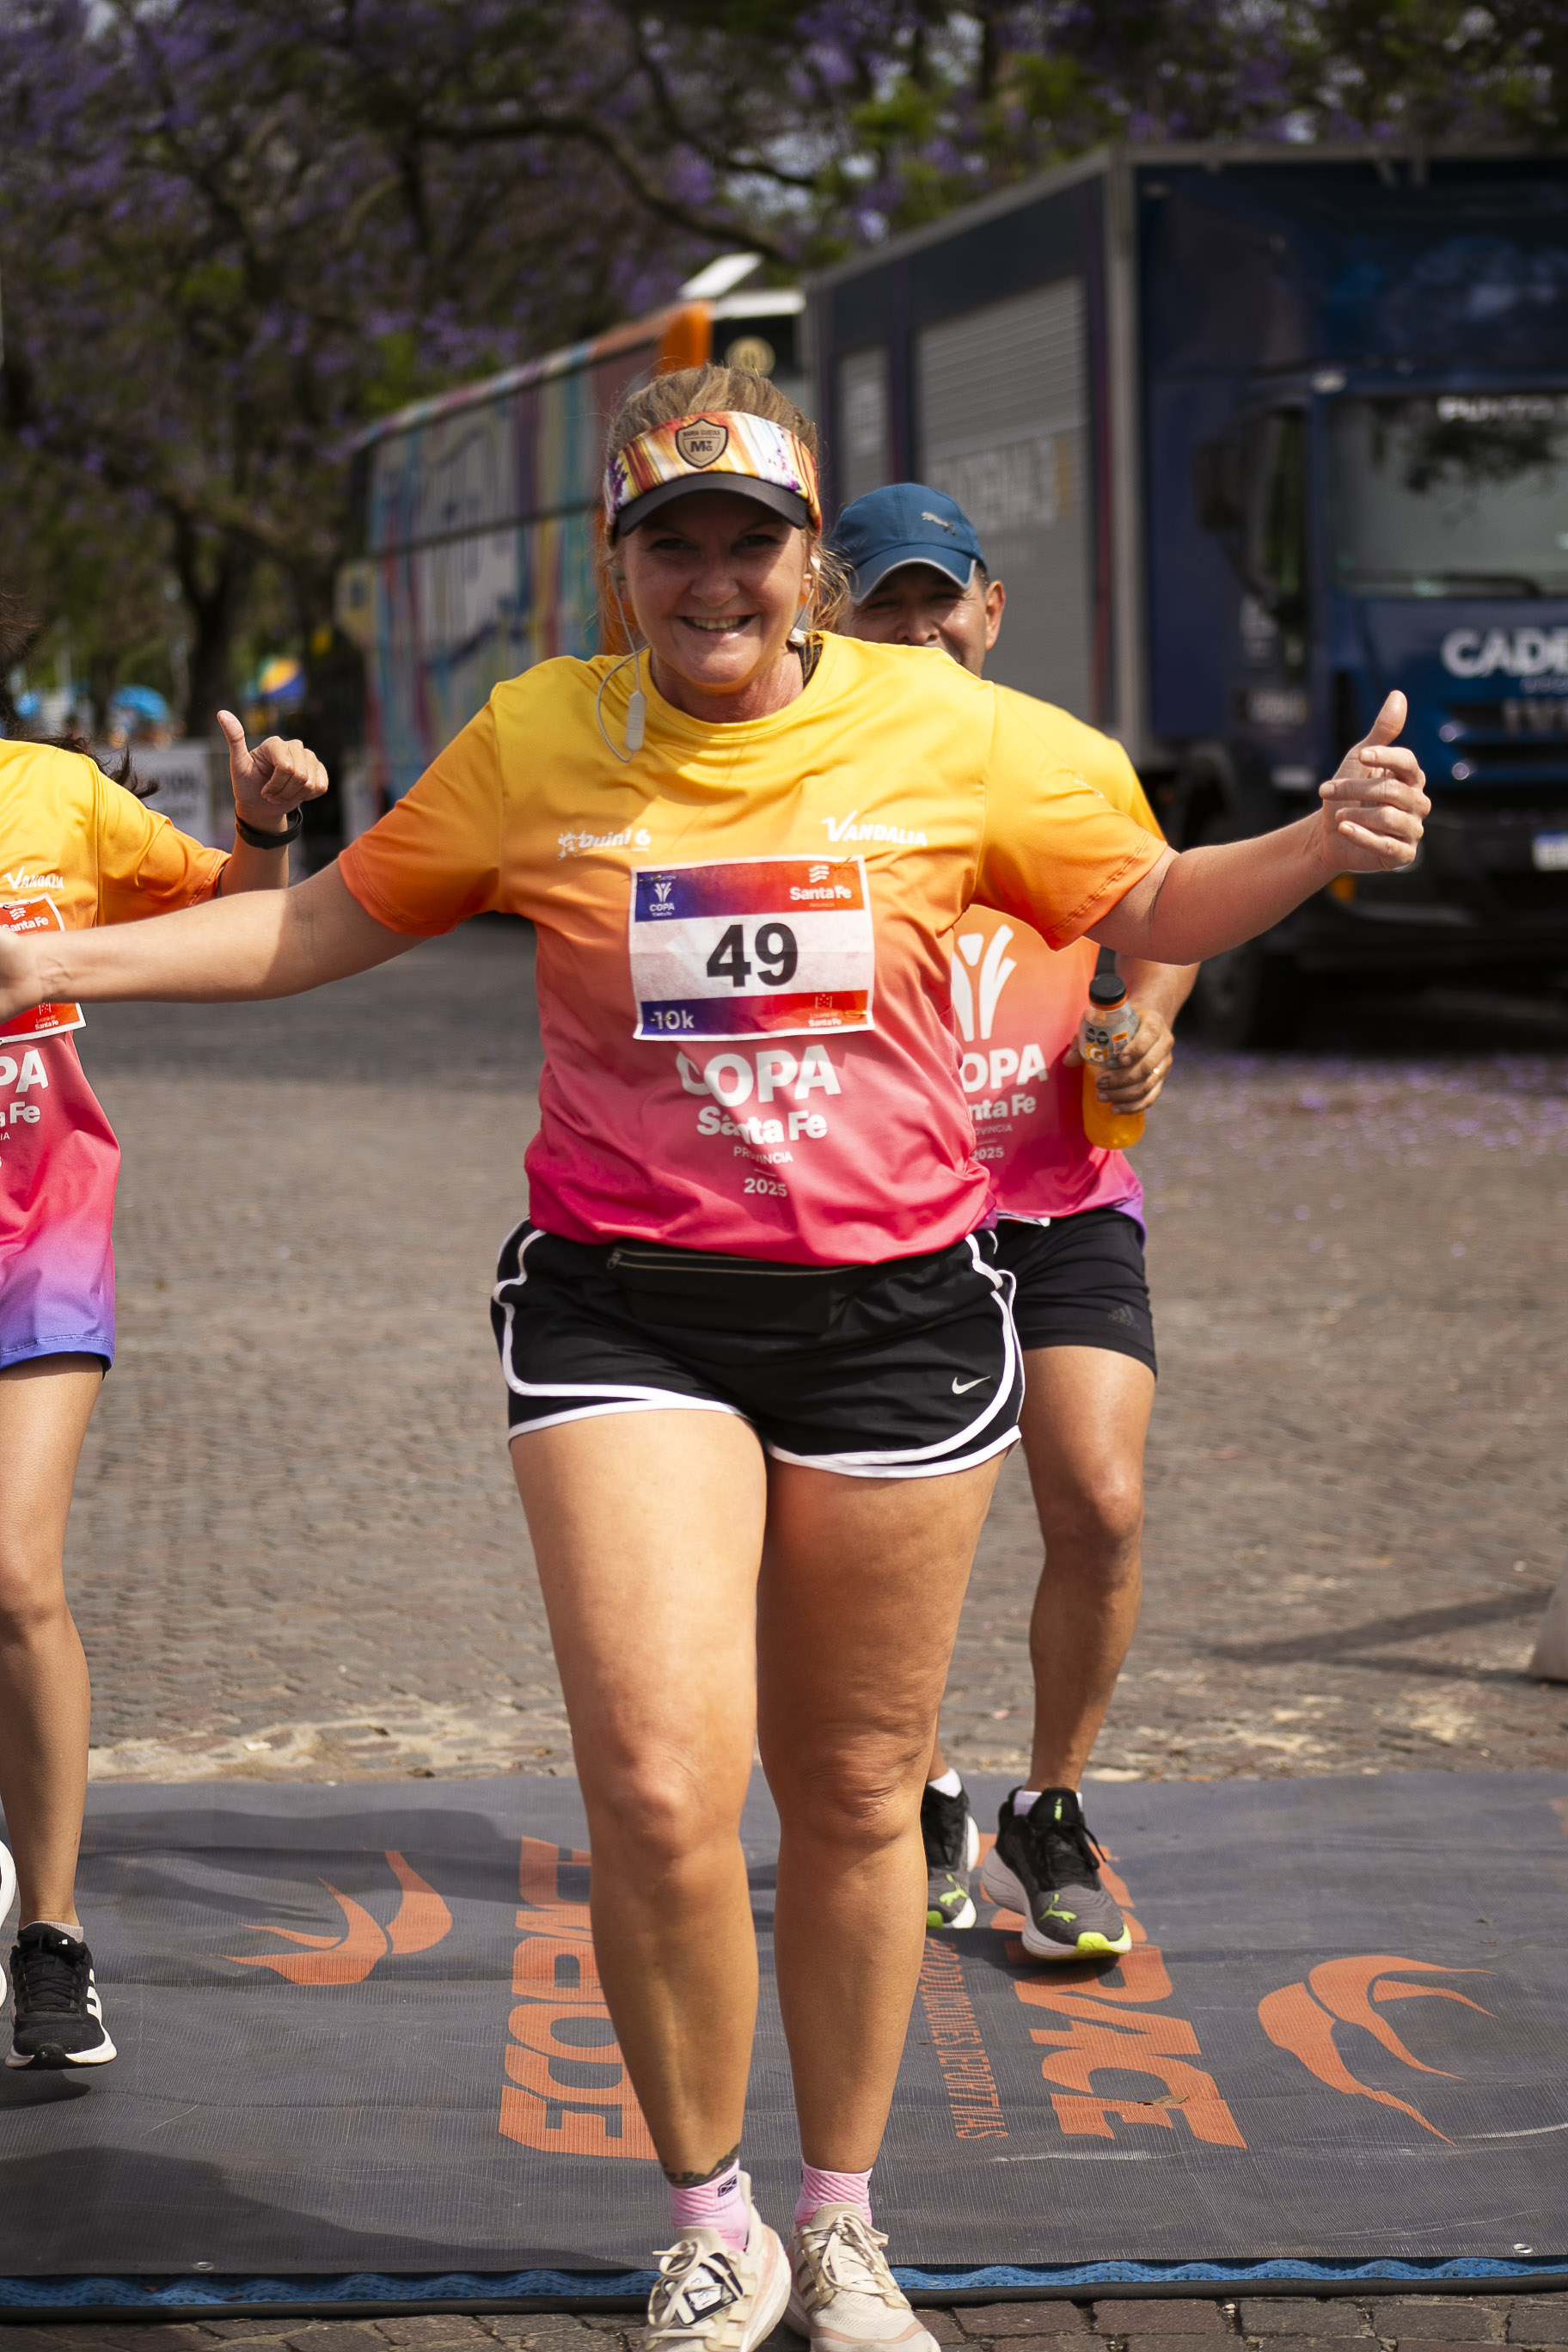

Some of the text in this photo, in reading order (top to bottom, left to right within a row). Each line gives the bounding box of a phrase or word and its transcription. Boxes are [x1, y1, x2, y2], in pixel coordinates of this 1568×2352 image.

[634, 828, 651, 846] 6
[821, 809, 928, 847] VANDALIA
[790, 885, 852, 900] Santa Fe
[649, 903, 675, 912] COPA
[34, 916, 49, 927] Fe
[707, 922, 798, 987] 49
[654, 1009, 695, 1030] 10k
[959, 1044, 1048, 1093] OPA
[9, 1101, 40, 1124] Fe
[968, 1093, 1037, 1121] nta Fe
[787, 1110, 828, 1141] Fe
[974, 1124, 1013, 1135] OVINCIA
[744, 1178, 788, 1197] 2025
[936, 2049, 1009, 2140] DEPORTIVAS
